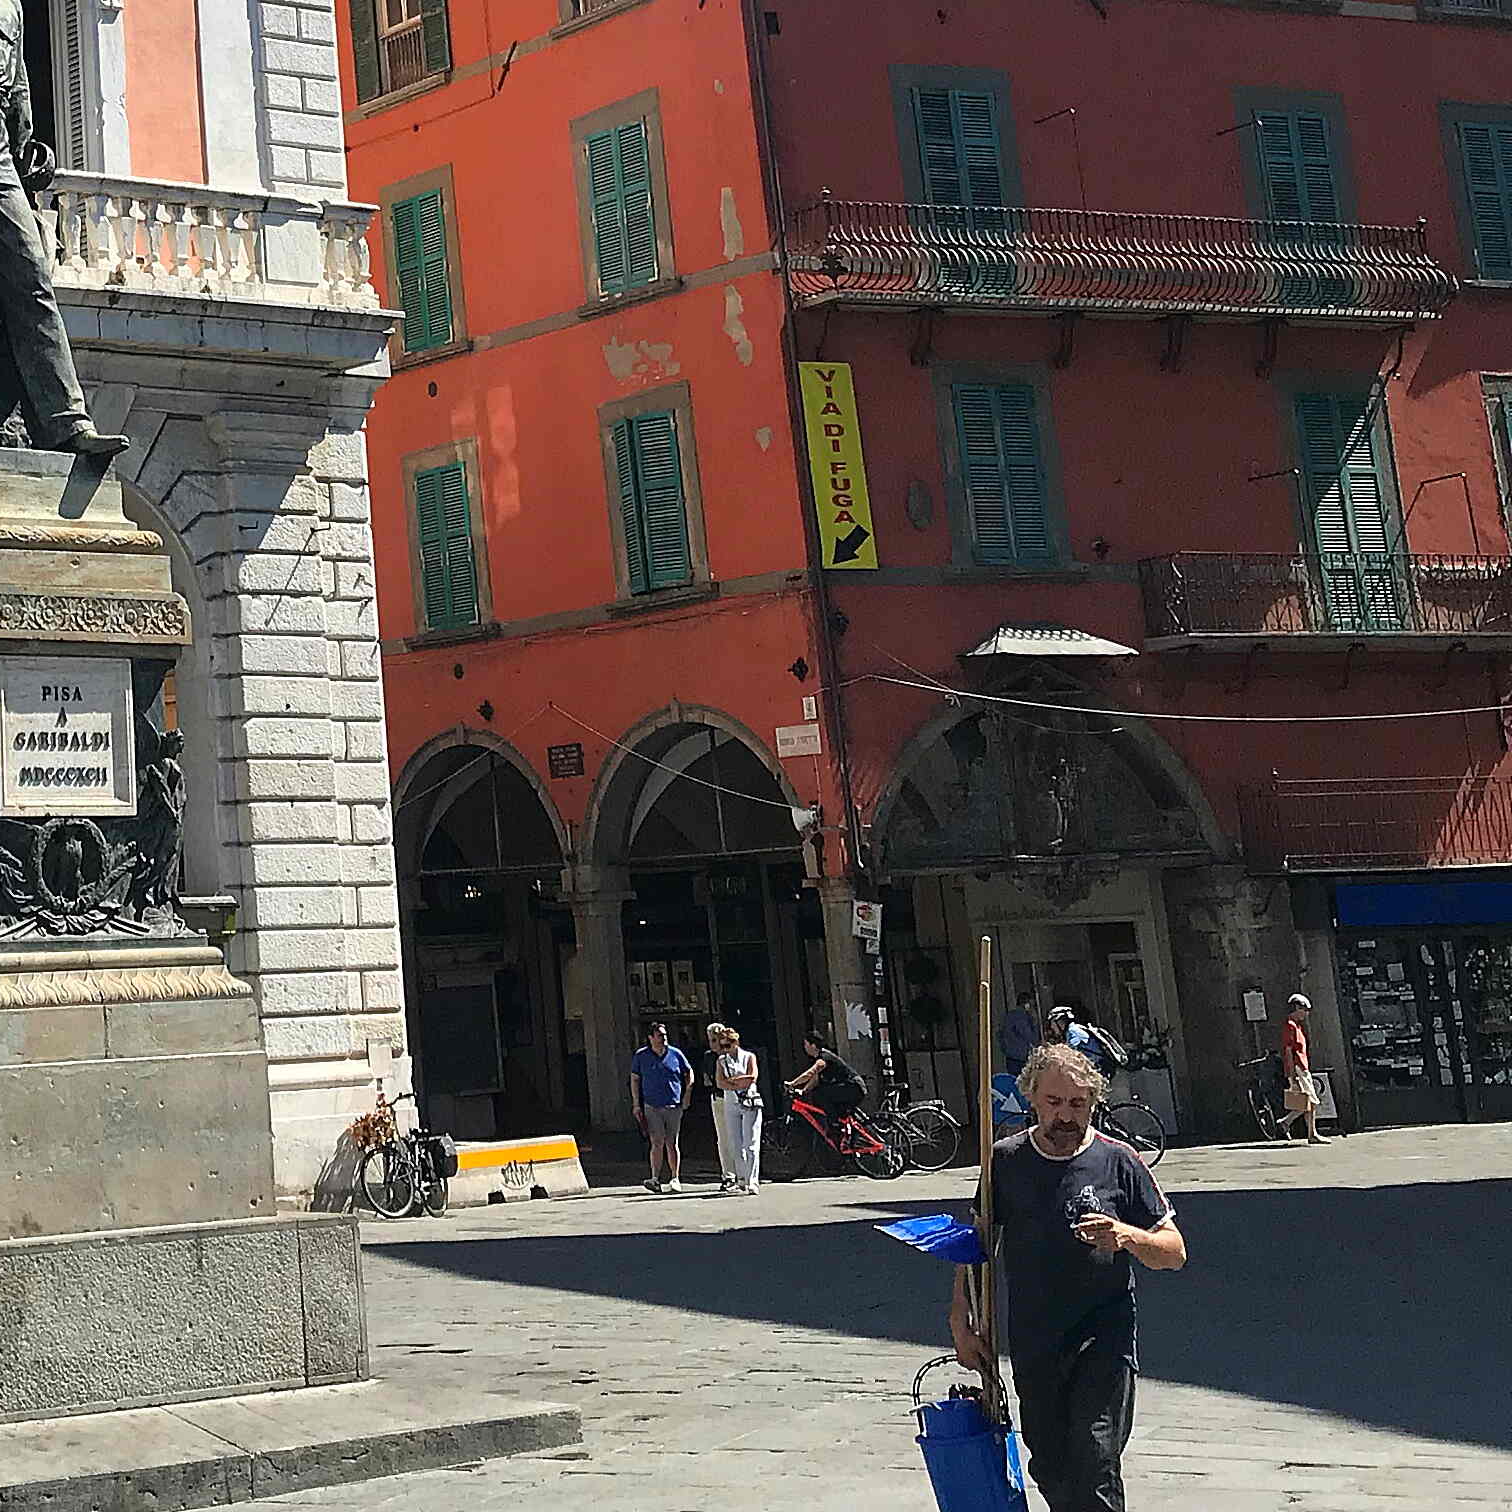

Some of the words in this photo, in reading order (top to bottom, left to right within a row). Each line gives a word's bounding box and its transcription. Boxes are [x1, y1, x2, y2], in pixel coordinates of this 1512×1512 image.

[814, 369, 842, 415] VIA
[823, 423, 845, 453] DI
[829, 462, 856, 524] FUGA
[40, 685, 83, 702] PISA
[54, 705, 68, 728] A
[13, 731, 111, 752] GARIBALDI
[18, 766, 108, 787] MDCCCXCII
